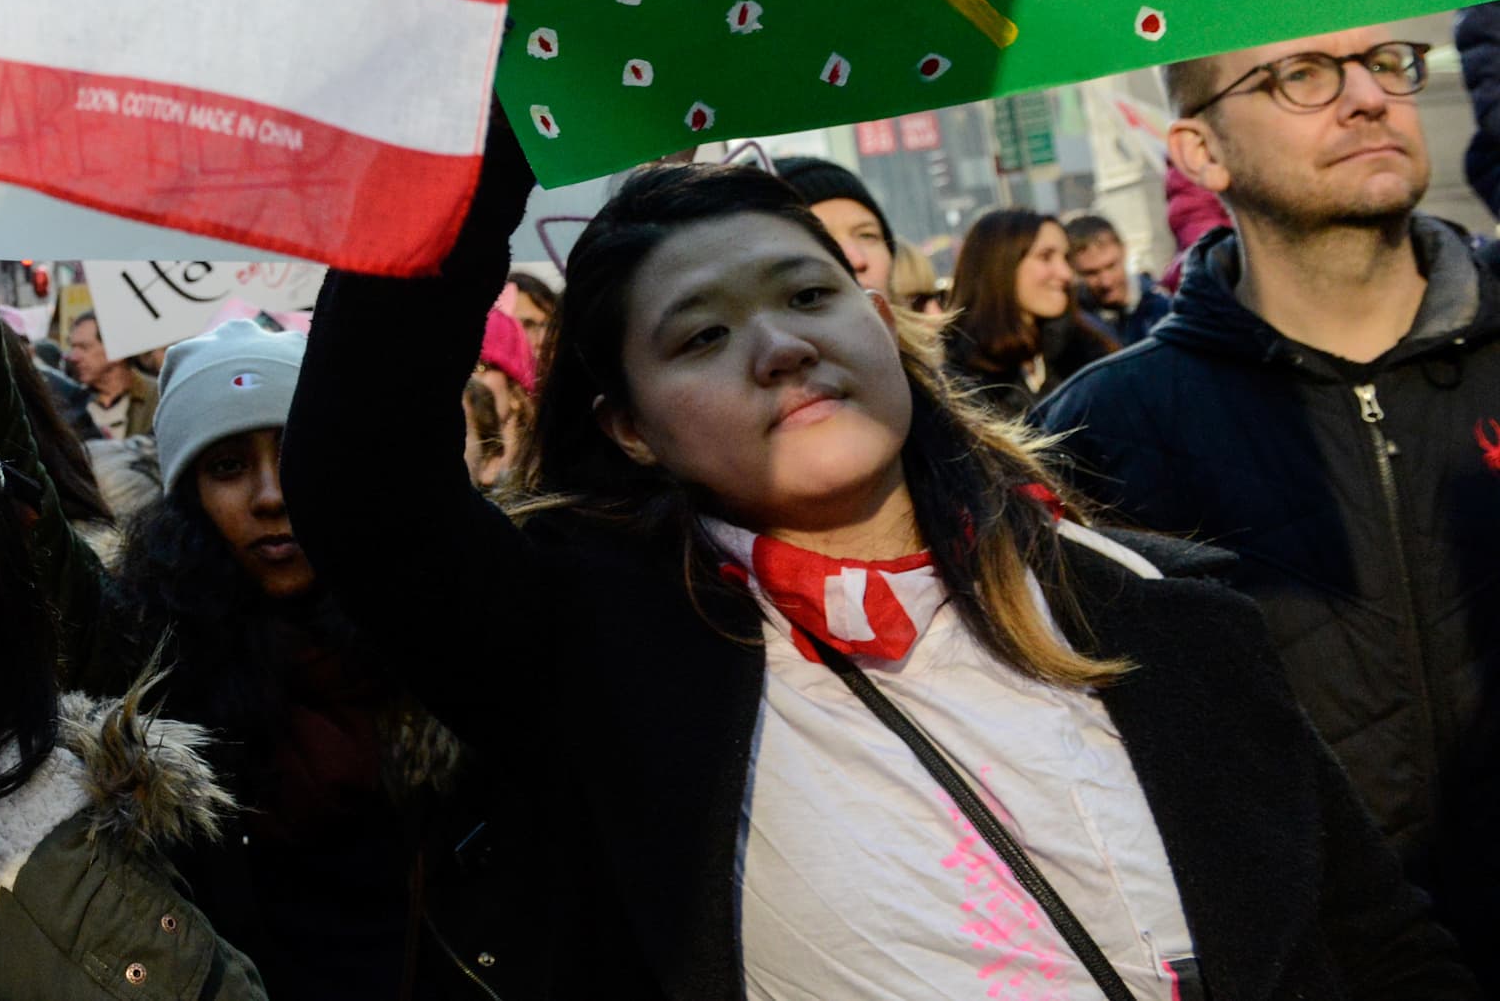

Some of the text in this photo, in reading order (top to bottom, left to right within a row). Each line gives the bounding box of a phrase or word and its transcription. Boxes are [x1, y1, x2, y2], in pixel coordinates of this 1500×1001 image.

[75, 86, 303, 151] 100% COTTON MADE IN CHINA
